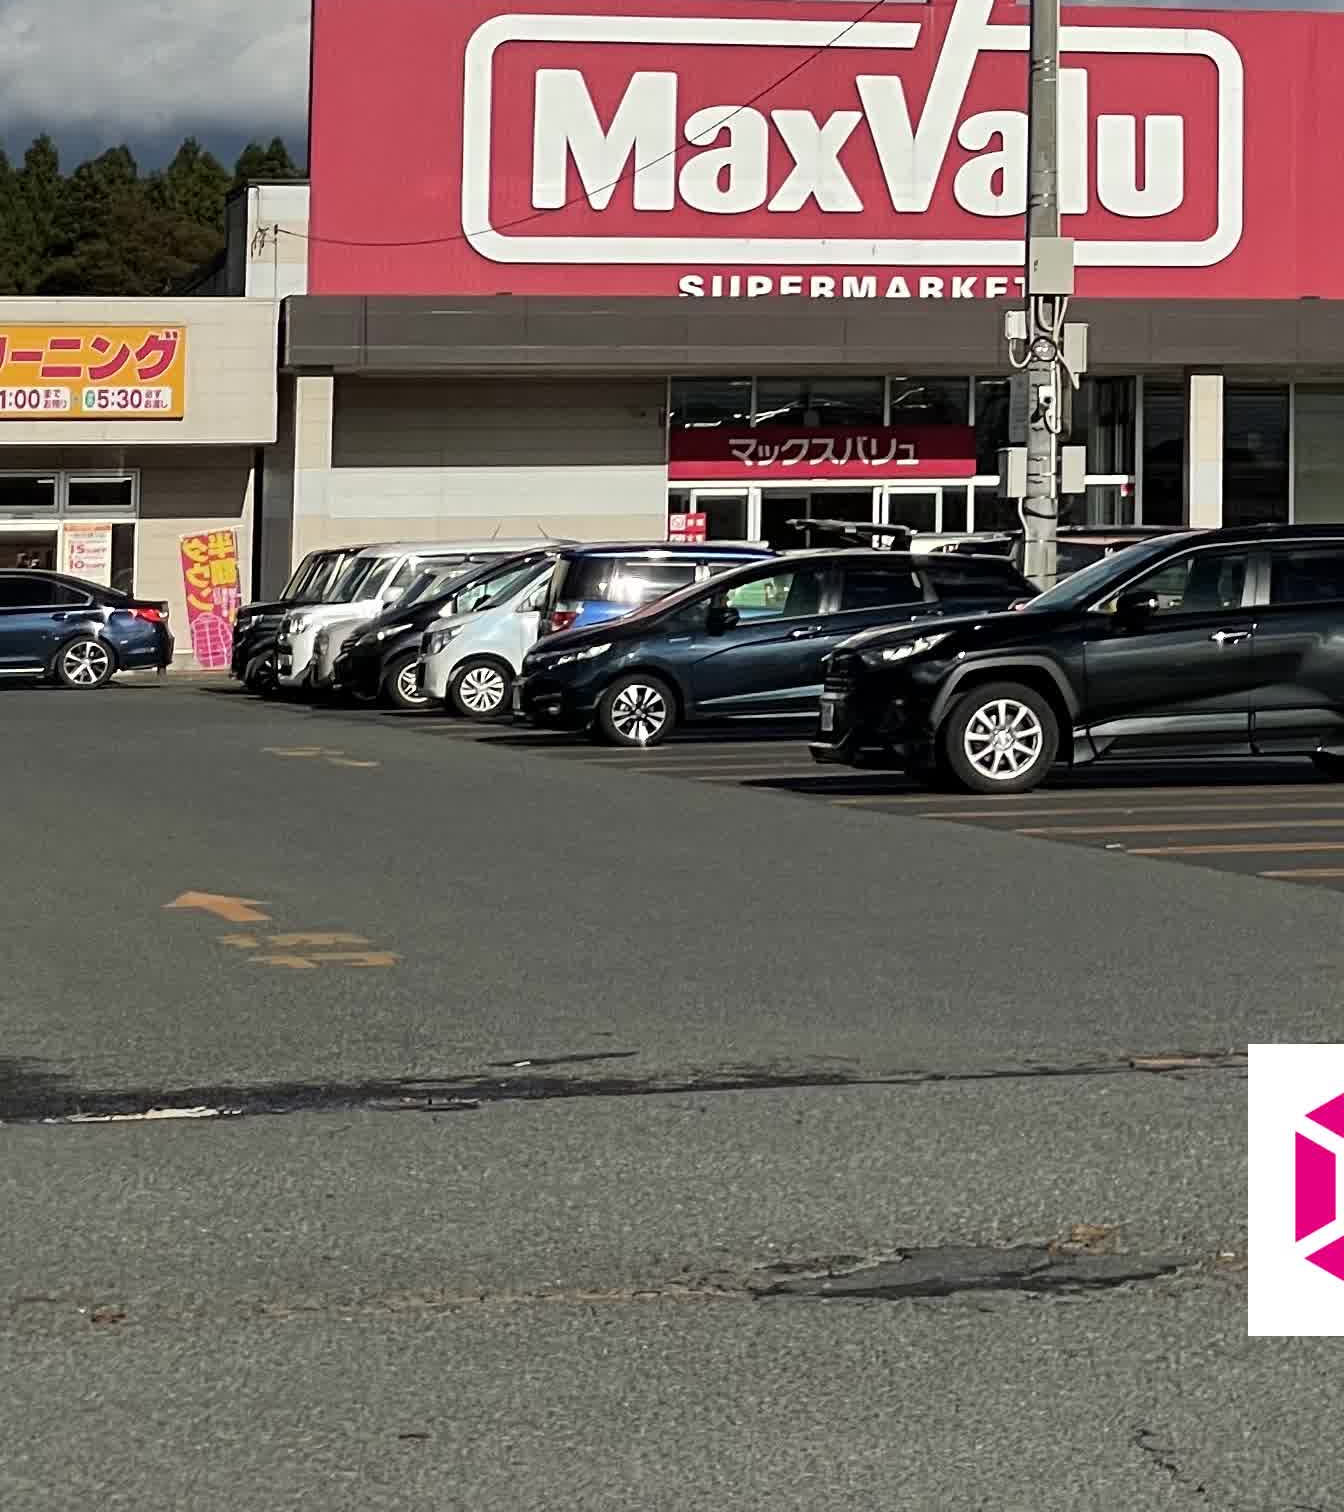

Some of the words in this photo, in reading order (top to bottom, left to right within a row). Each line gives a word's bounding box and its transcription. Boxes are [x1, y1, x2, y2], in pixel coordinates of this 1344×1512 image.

[728, 437, 920, 466] マックスバリュ
